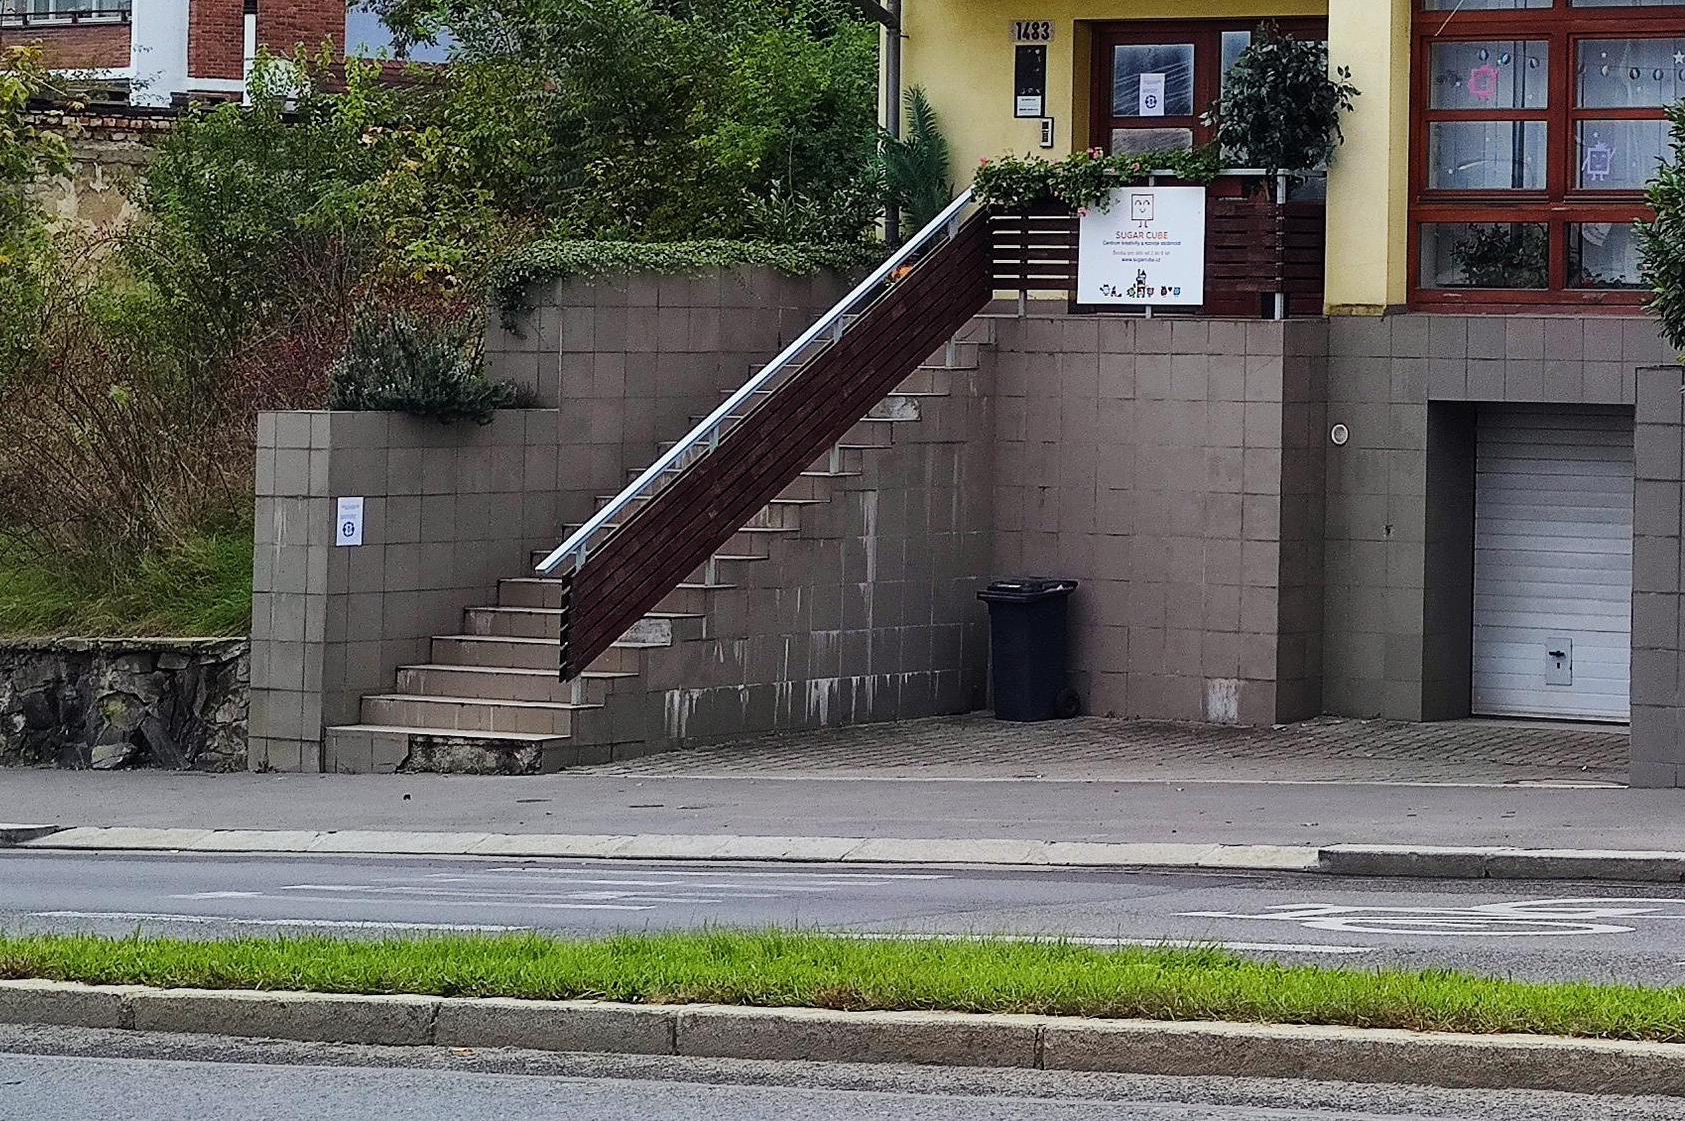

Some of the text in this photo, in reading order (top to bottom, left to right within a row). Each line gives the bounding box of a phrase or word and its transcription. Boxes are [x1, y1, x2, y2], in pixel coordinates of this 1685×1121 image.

[1015, 21, 1050, 40] 1483
[1115, 231, 1169, 239] SUGAR CUBE
